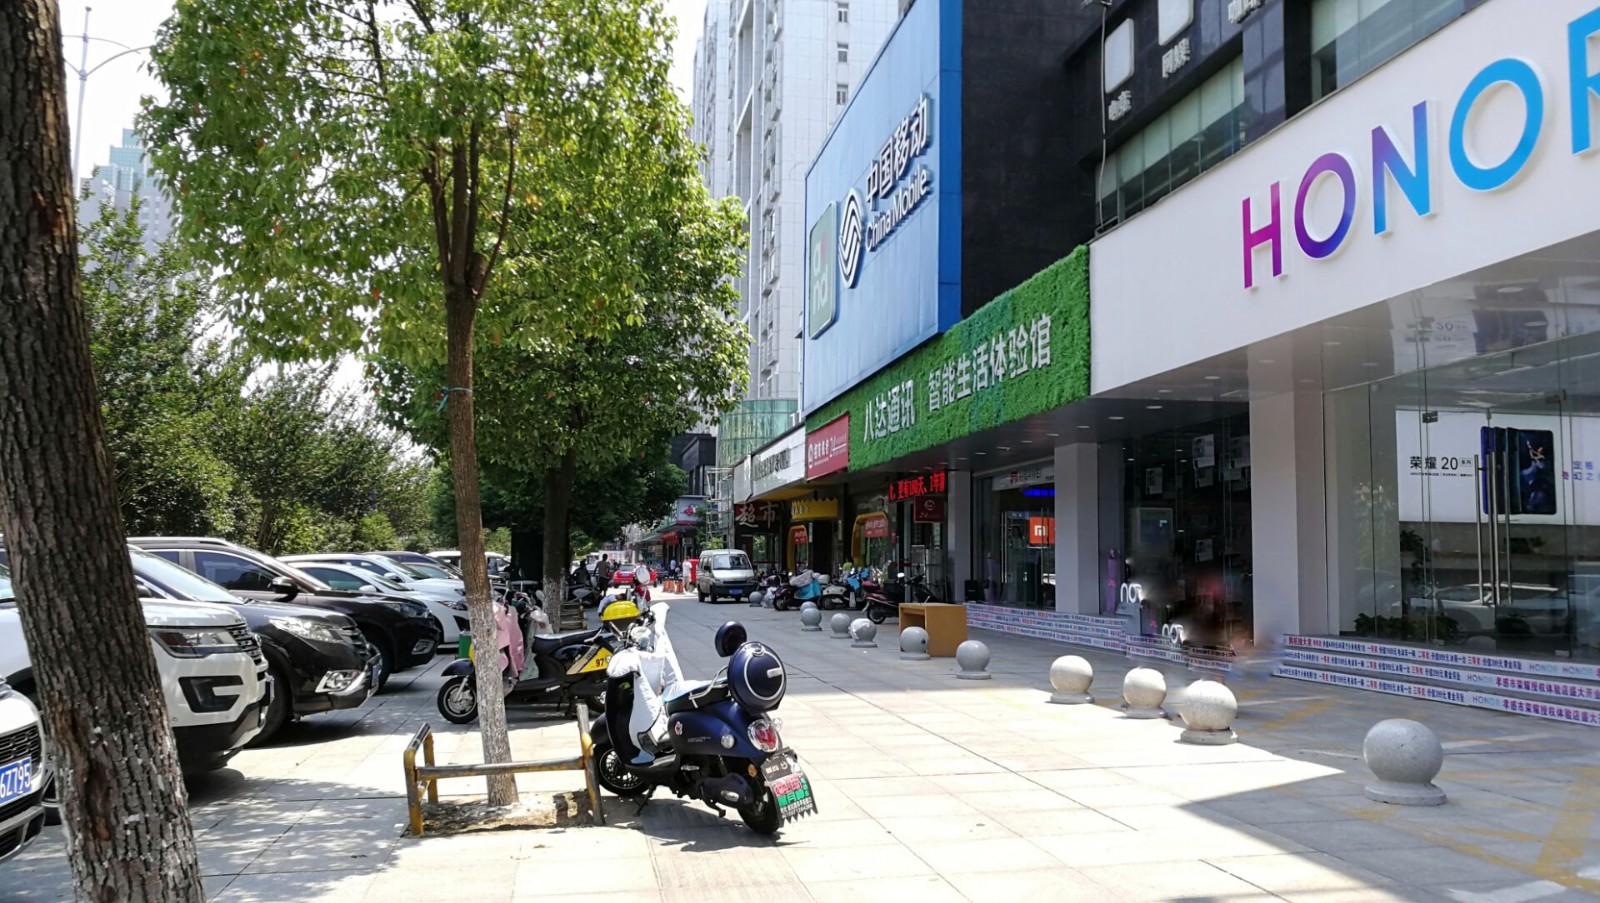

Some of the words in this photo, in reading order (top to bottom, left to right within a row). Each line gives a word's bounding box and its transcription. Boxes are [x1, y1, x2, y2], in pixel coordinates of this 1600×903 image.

[866, 93, 930, 210] 中国移动
[866, 213, 891, 251] China
[893, 167, 929, 226] Mobile
[863, 379, 915, 443] 八达通讯
[928, 313, 1052, 412] 智能生活体验馆
[1410, 456, 1436, 469] 荣耀
[1441, 457, 1458, 470] 20
[735, 502, 779, 529] 超市
[1503, 699, 1600, 725] 孝感市荣耀授权体验店盛大
